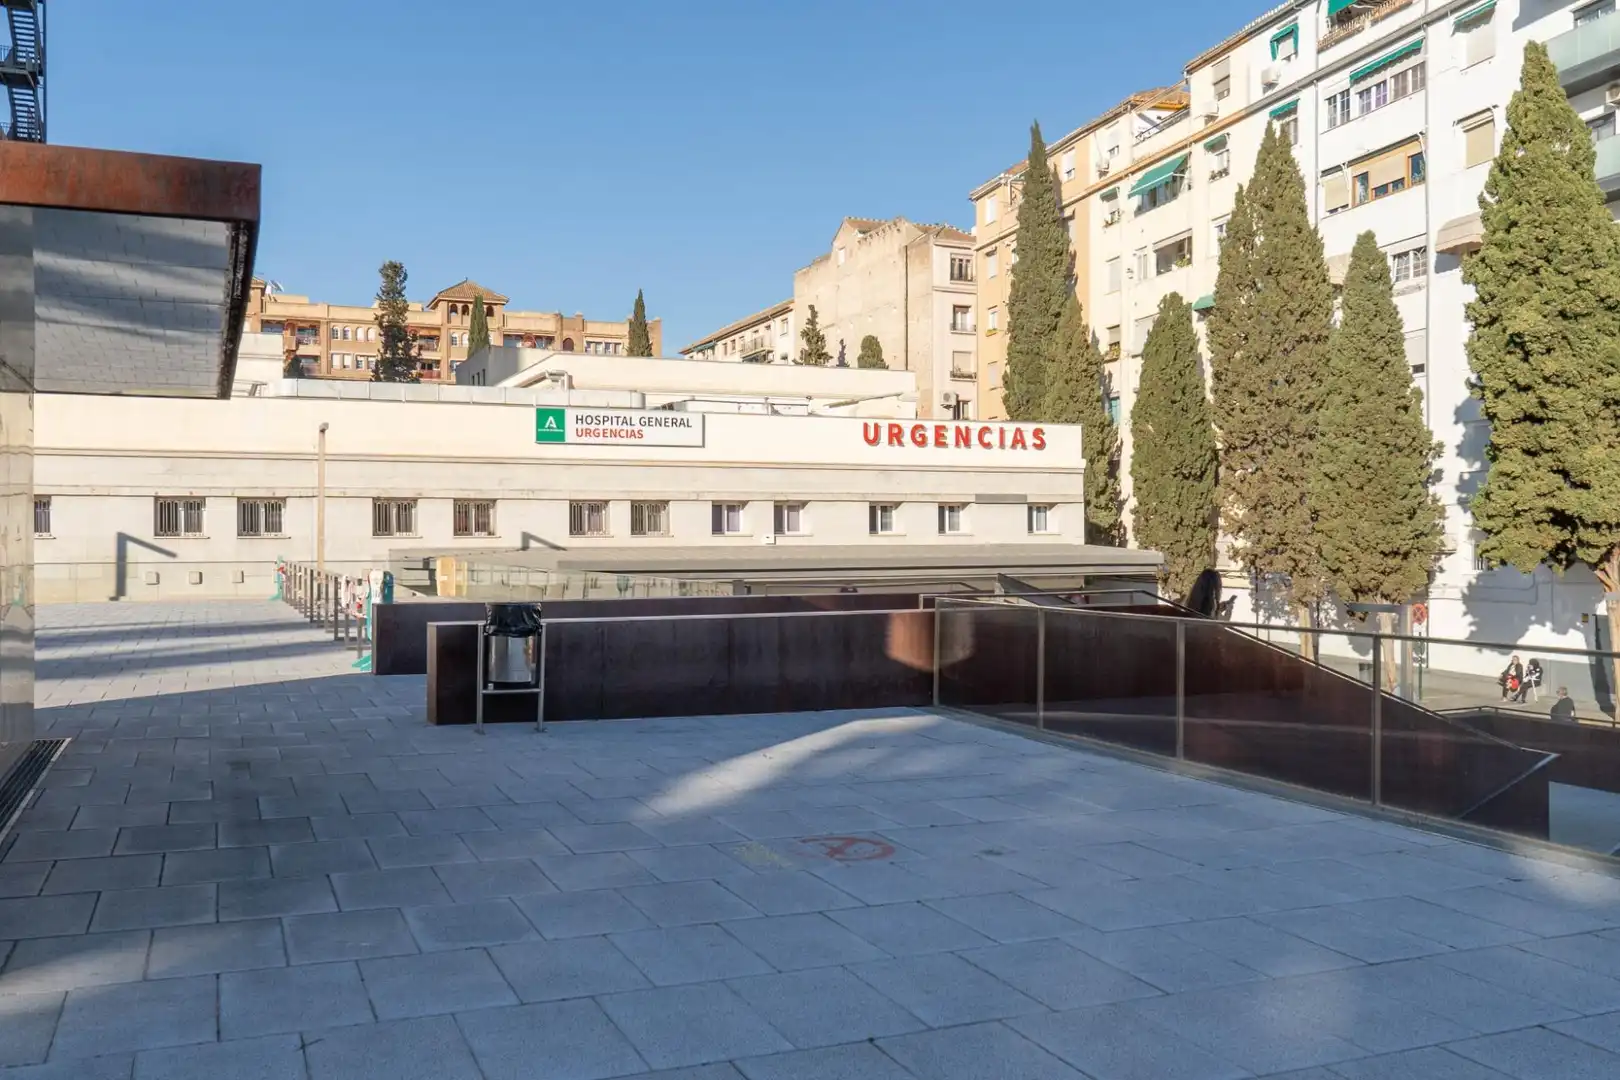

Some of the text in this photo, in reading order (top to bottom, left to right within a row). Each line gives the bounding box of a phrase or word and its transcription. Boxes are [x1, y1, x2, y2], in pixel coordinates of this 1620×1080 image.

[575, 414, 692, 428] HOSPITAL GENERAL
[575, 427, 644, 439] URGENCIAS
[863, 421, 1047, 450] URGENCIAS
